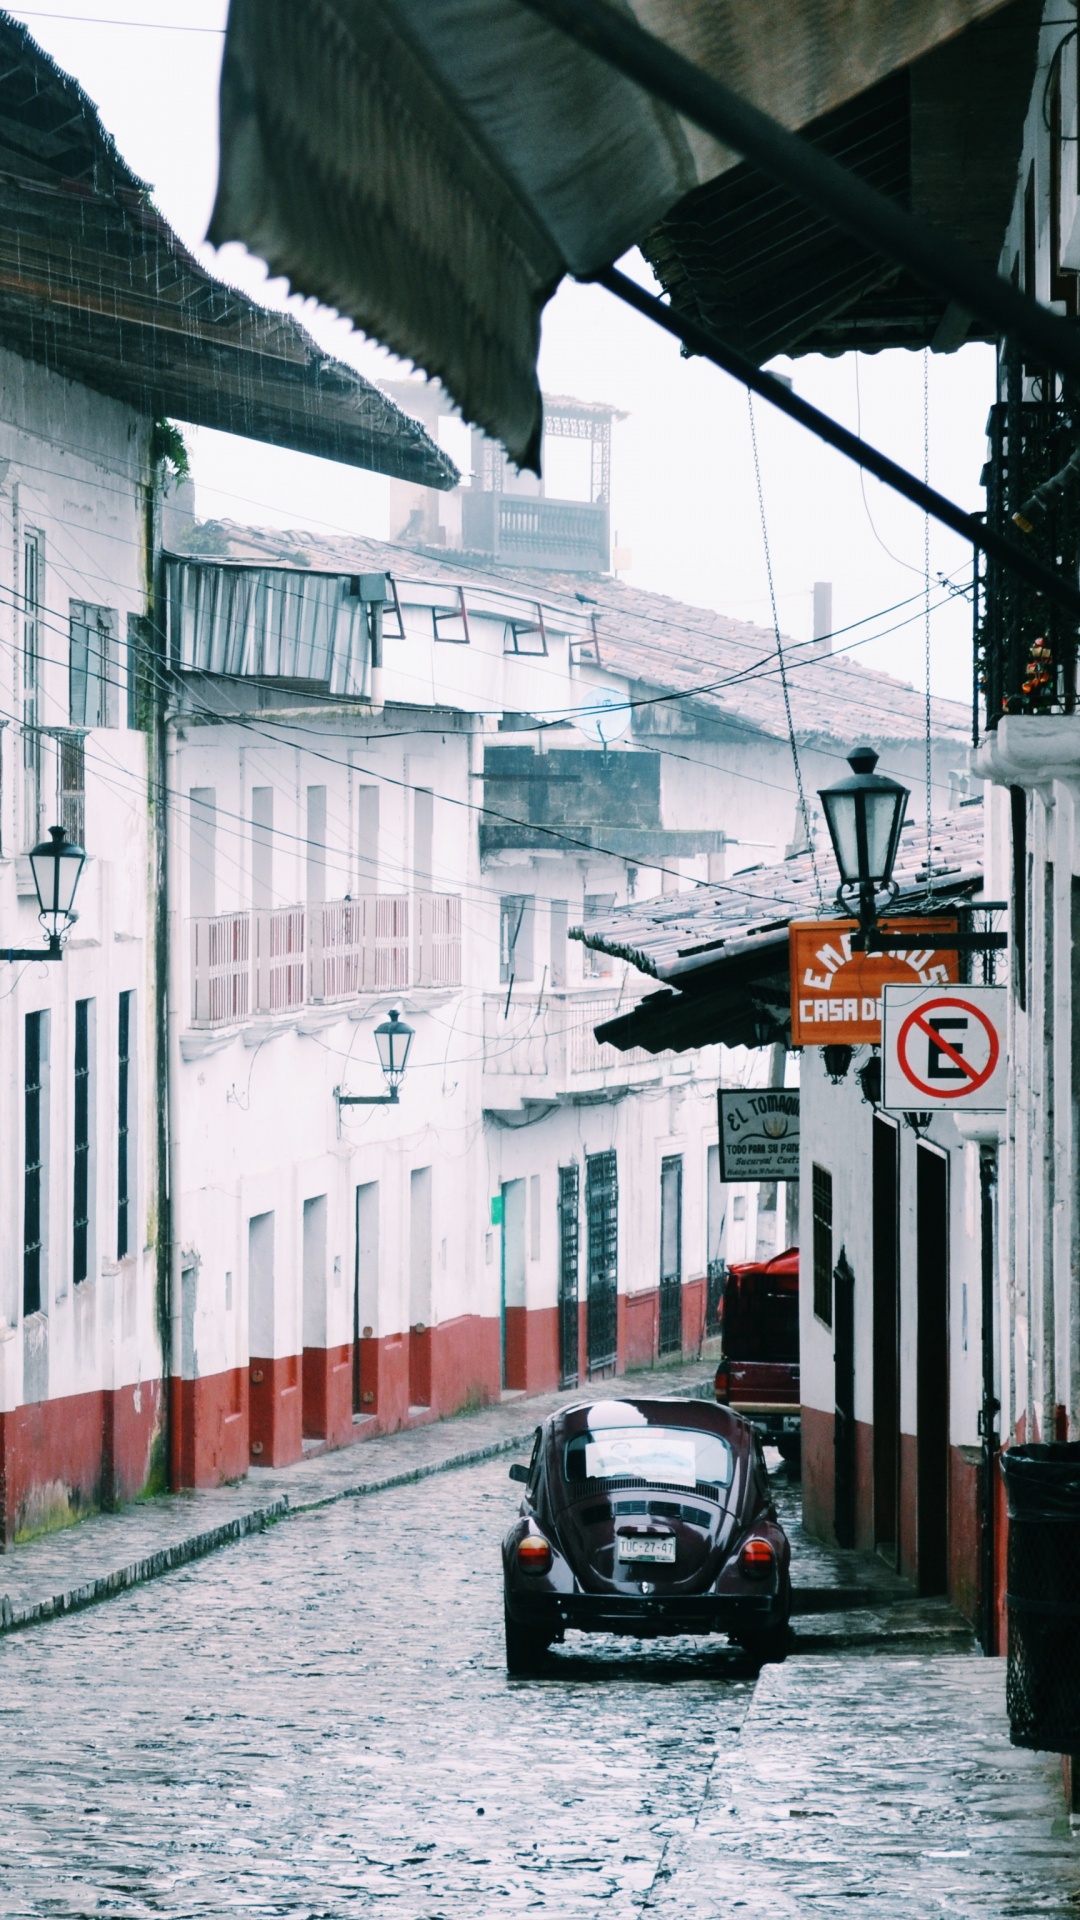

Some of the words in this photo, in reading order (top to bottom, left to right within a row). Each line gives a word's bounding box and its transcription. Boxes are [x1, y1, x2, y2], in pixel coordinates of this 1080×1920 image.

[799, 998, 858, 1022] CASA
[928, 1018, 968, 1079] E
[727, 1145, 747, 1155] TODO
[748, 1144, 766, 1154] PARA
[768, 1144, 778, 1153] SU
[736, 1157, 772, 1165] Sucursal
[620, 1541, 674, 1554] TUC-27-47
